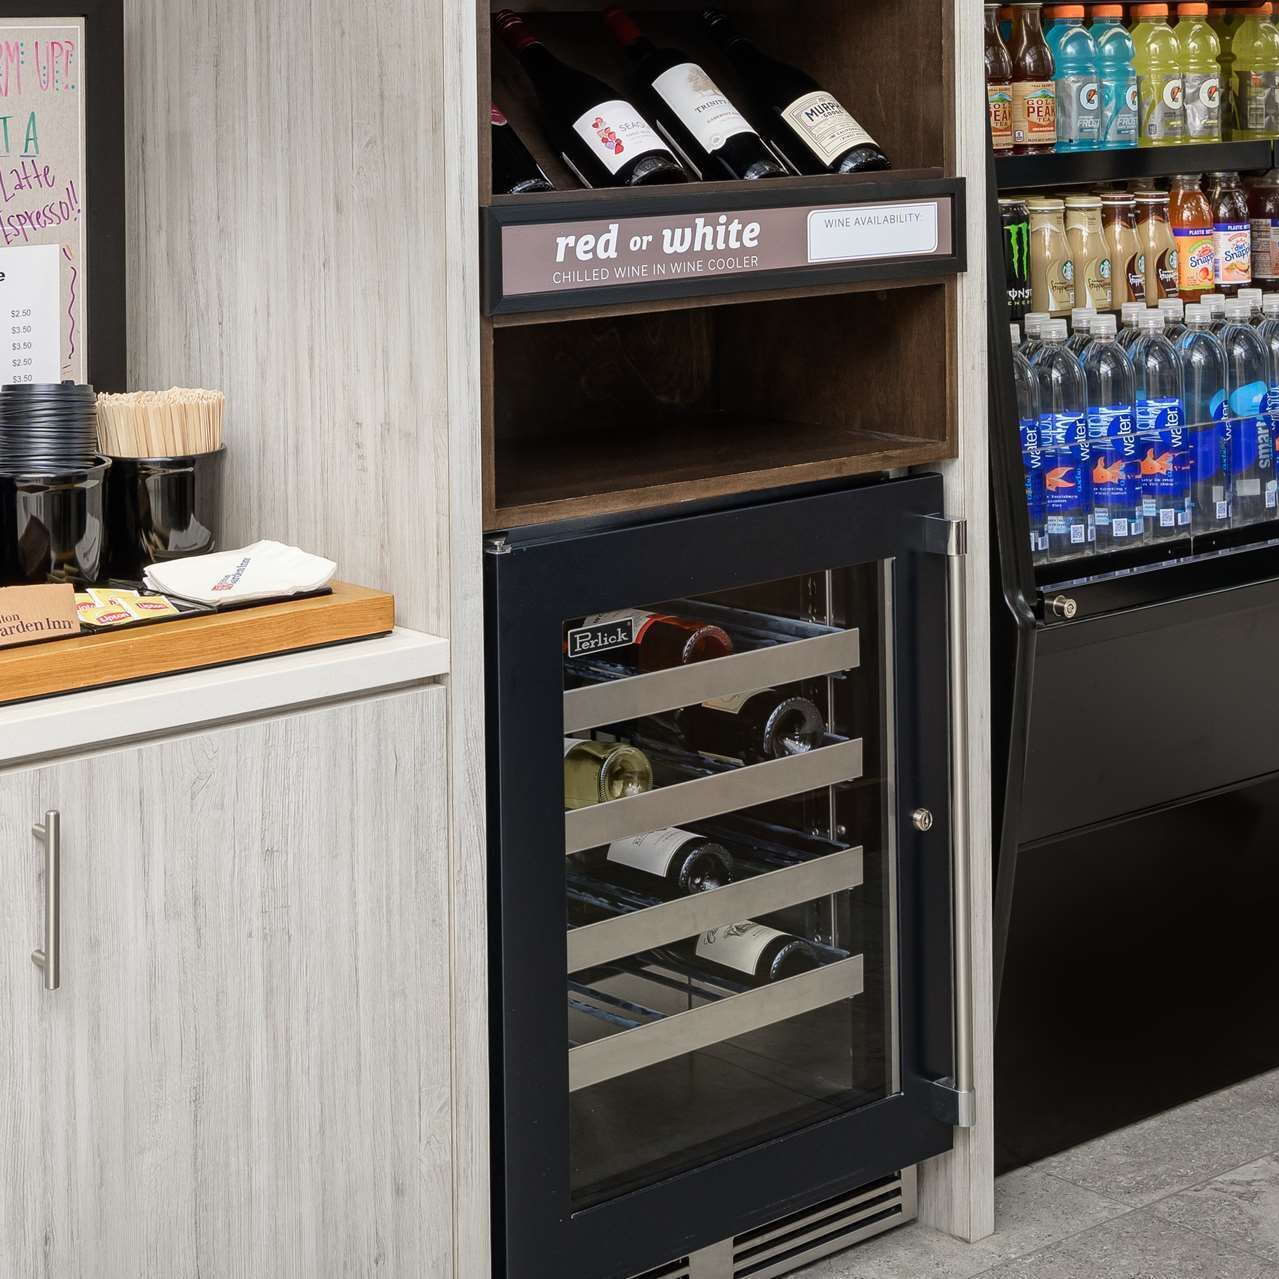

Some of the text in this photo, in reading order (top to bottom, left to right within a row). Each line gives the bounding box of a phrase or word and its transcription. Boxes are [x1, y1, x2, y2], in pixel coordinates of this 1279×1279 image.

[35, 40, 75, 91] UP?
[23, 111, 40, 155] A
[824, 212, 921, 229] WINE AVAILABILITY
[555, 214, 760, 262] red or white
[1189, 253, 1215, 268] Snapp
[1224, 247, 1250, 262] Snapp
[552, 255, 759, 284] CHILLED WINE IN WINE COOLER
[10, 309, 32, 318] $2.50
[11, 325, 32, 334] $3.50
[12, 342, 32, 351] $3.50
[12, 358, 32, 367] $2.50
[12, 374, 33, 383] $3.50
[46, 618, 71, 630] Inn
[99, 611, 130, 623] Lipton
[574, 628, 629, 652] Perlick
